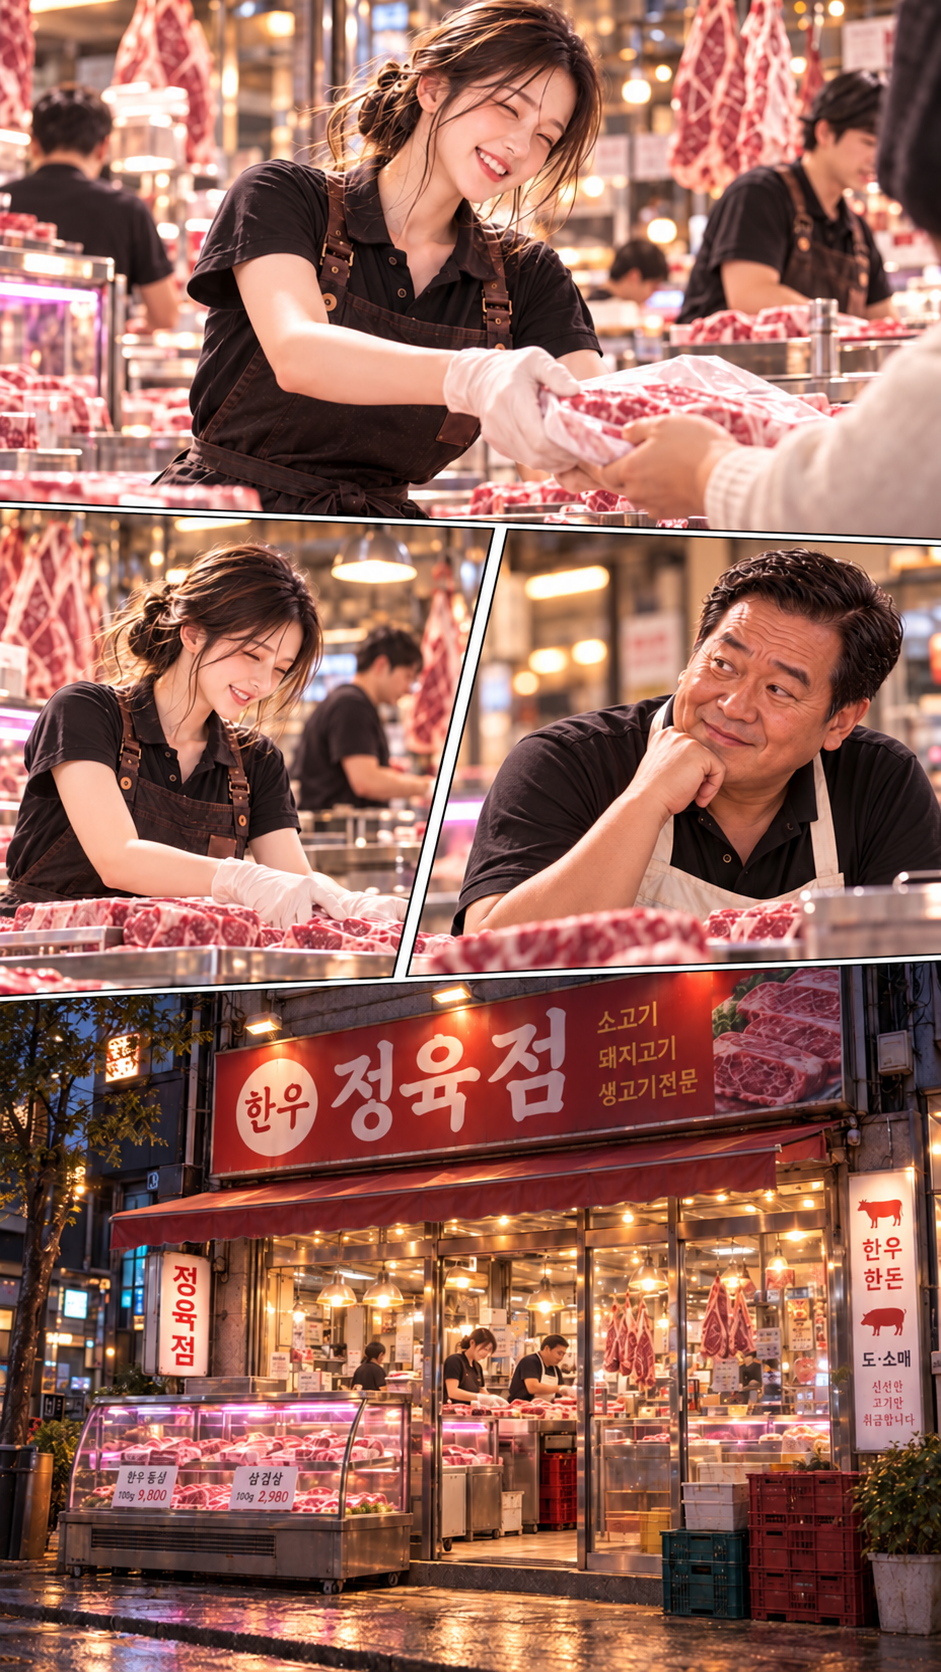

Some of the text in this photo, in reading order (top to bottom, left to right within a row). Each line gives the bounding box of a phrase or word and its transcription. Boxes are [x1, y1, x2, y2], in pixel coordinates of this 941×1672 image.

[597, 1000, 657, 1034] 소고기
[598, 1035, 676, 1069] 돼지고기
[244, 1006, 567, 1142] 한우 정육점
[862, 1236, 903, 1262] 한우
[863, 1267, 904, 1291] 한돈
[170, 1265, 198, 1367] 정육점
[862, 1350, 911, 1368] 도·소매
[137, 1489, 168, 1503] 9,800
[236, 1490, 289, 1504] 100g 2,980
